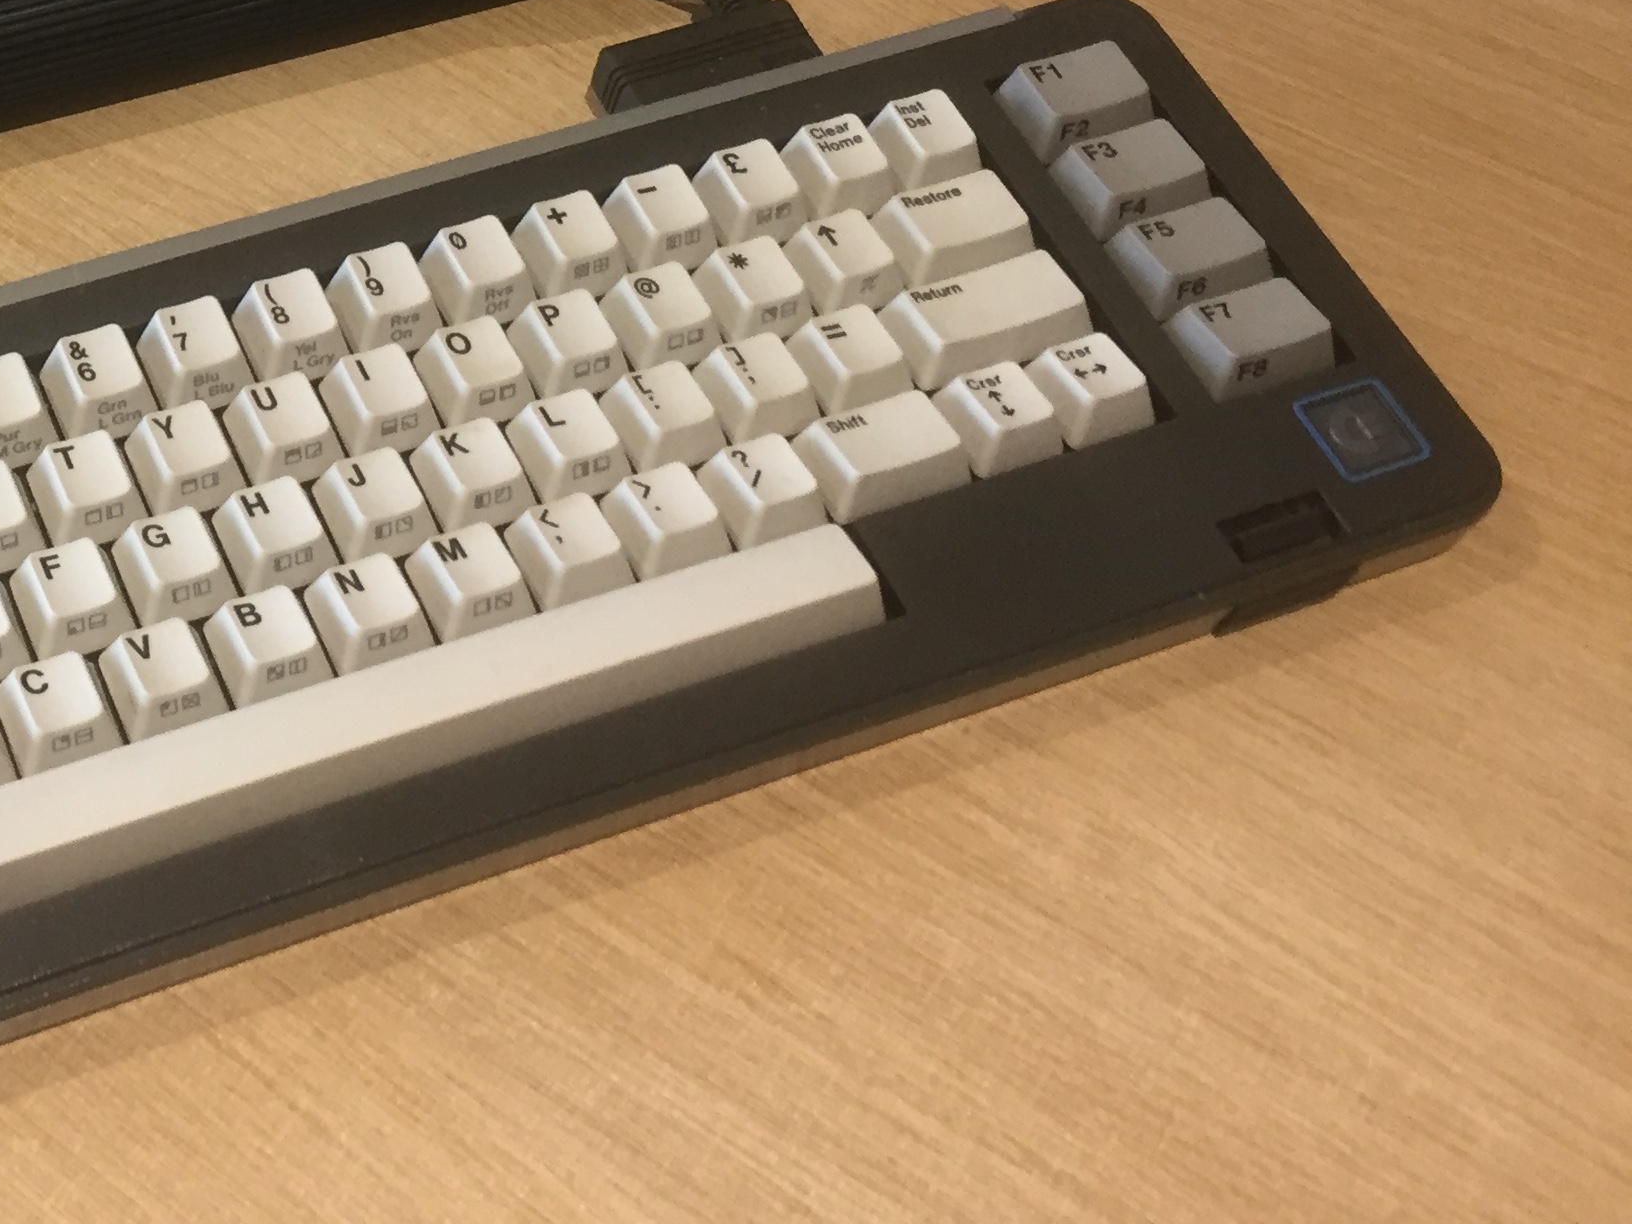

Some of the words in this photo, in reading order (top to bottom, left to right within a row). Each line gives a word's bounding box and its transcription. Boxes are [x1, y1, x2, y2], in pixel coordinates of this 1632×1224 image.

[1028, 63, 1063, 83] F1
[896, 101, 926, 117] Inst
[810, 121, 850, 141] Clear
[904, 114, 932, 130] Del
[1059, 120, 1090, 142] F2
[818, 134, 863, 154] Home
[1081, 142, 1118, 161] F3
[722, 153, 748, 175] £
[901, 186, 962, 209] Restore
[1118, 197, 1147, 220] F4
[1138, 220, 1176, 241] F5
[365, 277, 385, 297] 9
[633, 276, 661, 300] @
[910, 282, 964, 304] Return
[1176, 277, 1208, 301] F6
[271, 305, 291, 325] 8
[537, 303, 561, 327] P
[1198, 301, 1233, 322] F7
[172, 332, 188, 352] 7
[390, 326, 414, 342] On
[444, 331, 473, 355] O
[68, 341, 89, 360] &
[1055, 345, 1092, 363] Crsr
[77, 362, 97, 382] 6
[355, 359, 371, 382] I
[966, 374, 1003, 392] Crsr
[250, 387, 279, 411] U
[151, 414, 175, 440] Y
[537, 405, 566, 427] L
[826, 414, 869, 434] Shift
[439, 432, 470, 457] K
[53, 445, 77, 470] T
[346, 462, 367, 487] J
[239, 491, 270, 517] H
[141, 524, 172, 549] G
[432, 537, 469, 564] M
[39, 554, 62, 580] F
[333, 568, 366, 595] N
[233, 602, 264, 628] B
[125, 634, 152, 661] V
[20, 669, 50, 695] C
